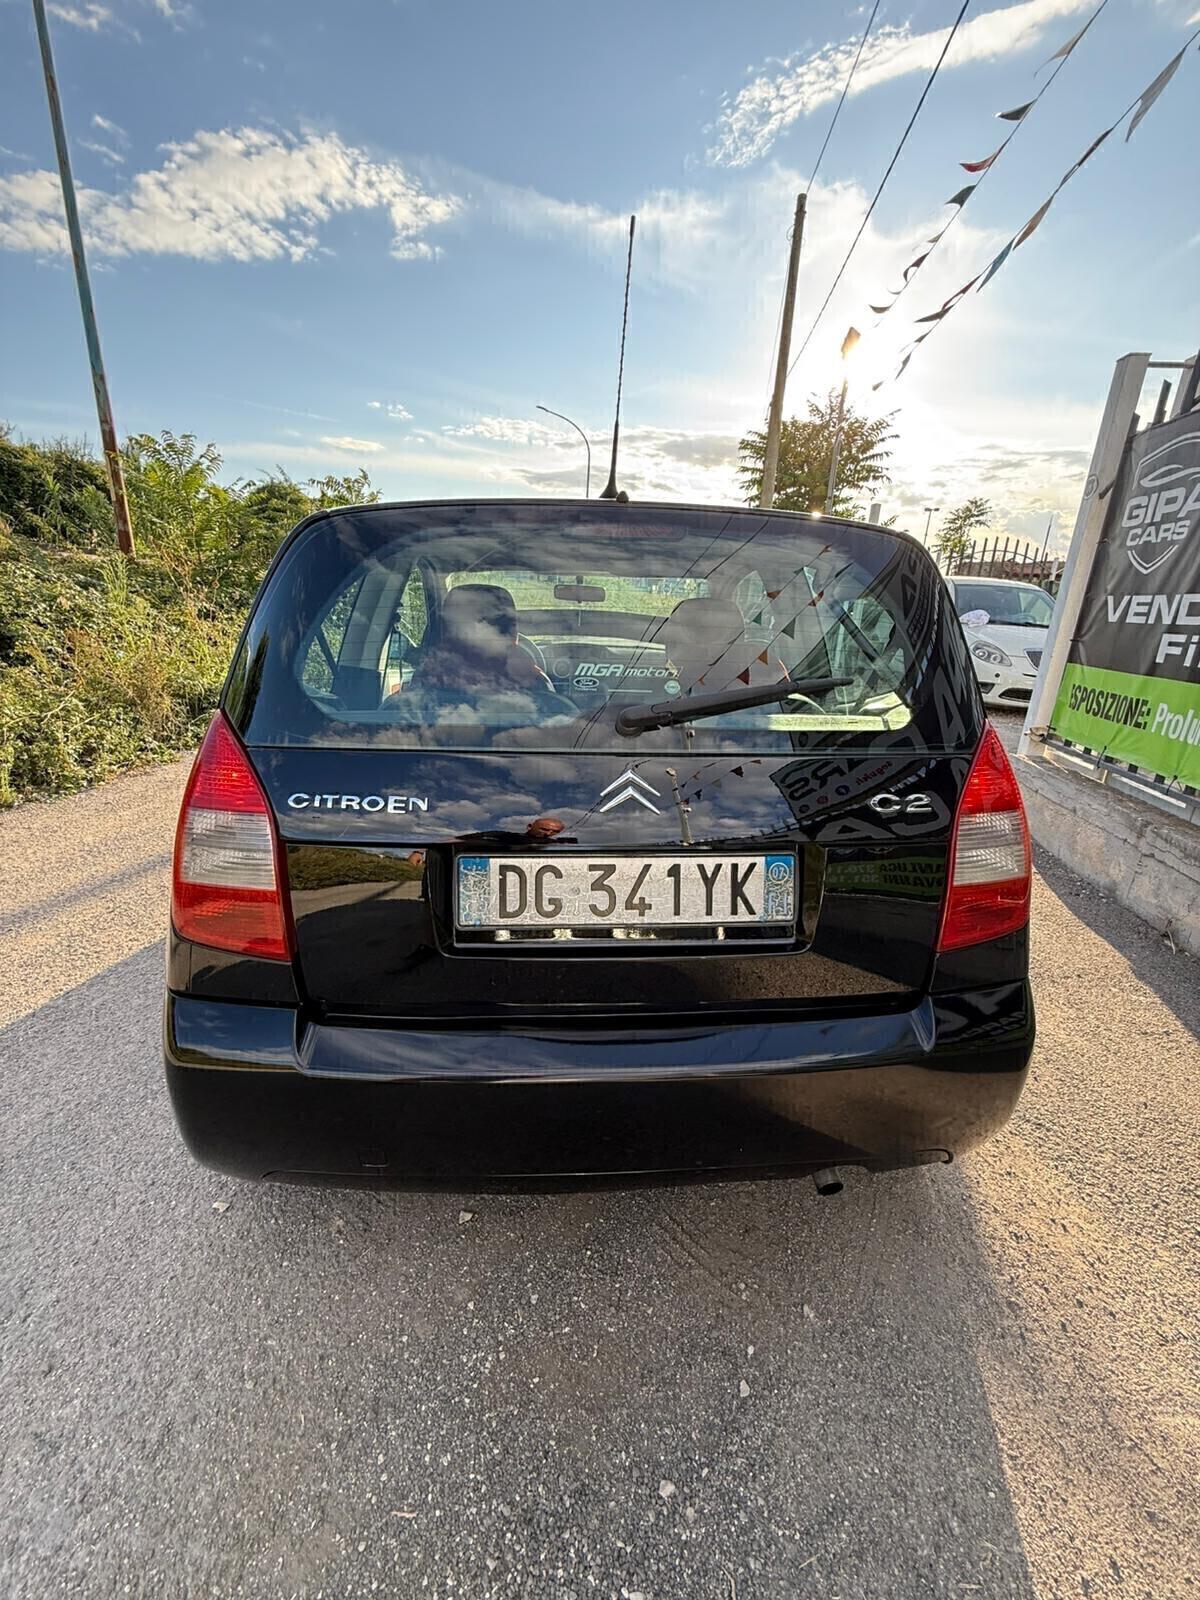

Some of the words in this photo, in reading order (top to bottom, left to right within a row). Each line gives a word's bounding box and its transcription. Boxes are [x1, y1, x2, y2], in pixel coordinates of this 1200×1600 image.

[1126, 520, 1190, 547] CARS
[1155, 633, 1200, 668] Fi
[574, 663, 625, 676] MGA
[1151, 702, 1200, 747] Prolu
[288, 793, 428, 814] CITROEN
[870, 793, 933, 813] C2
[499, 863, 564, 919] DG
[588, 862, 757, 917] 341YK
